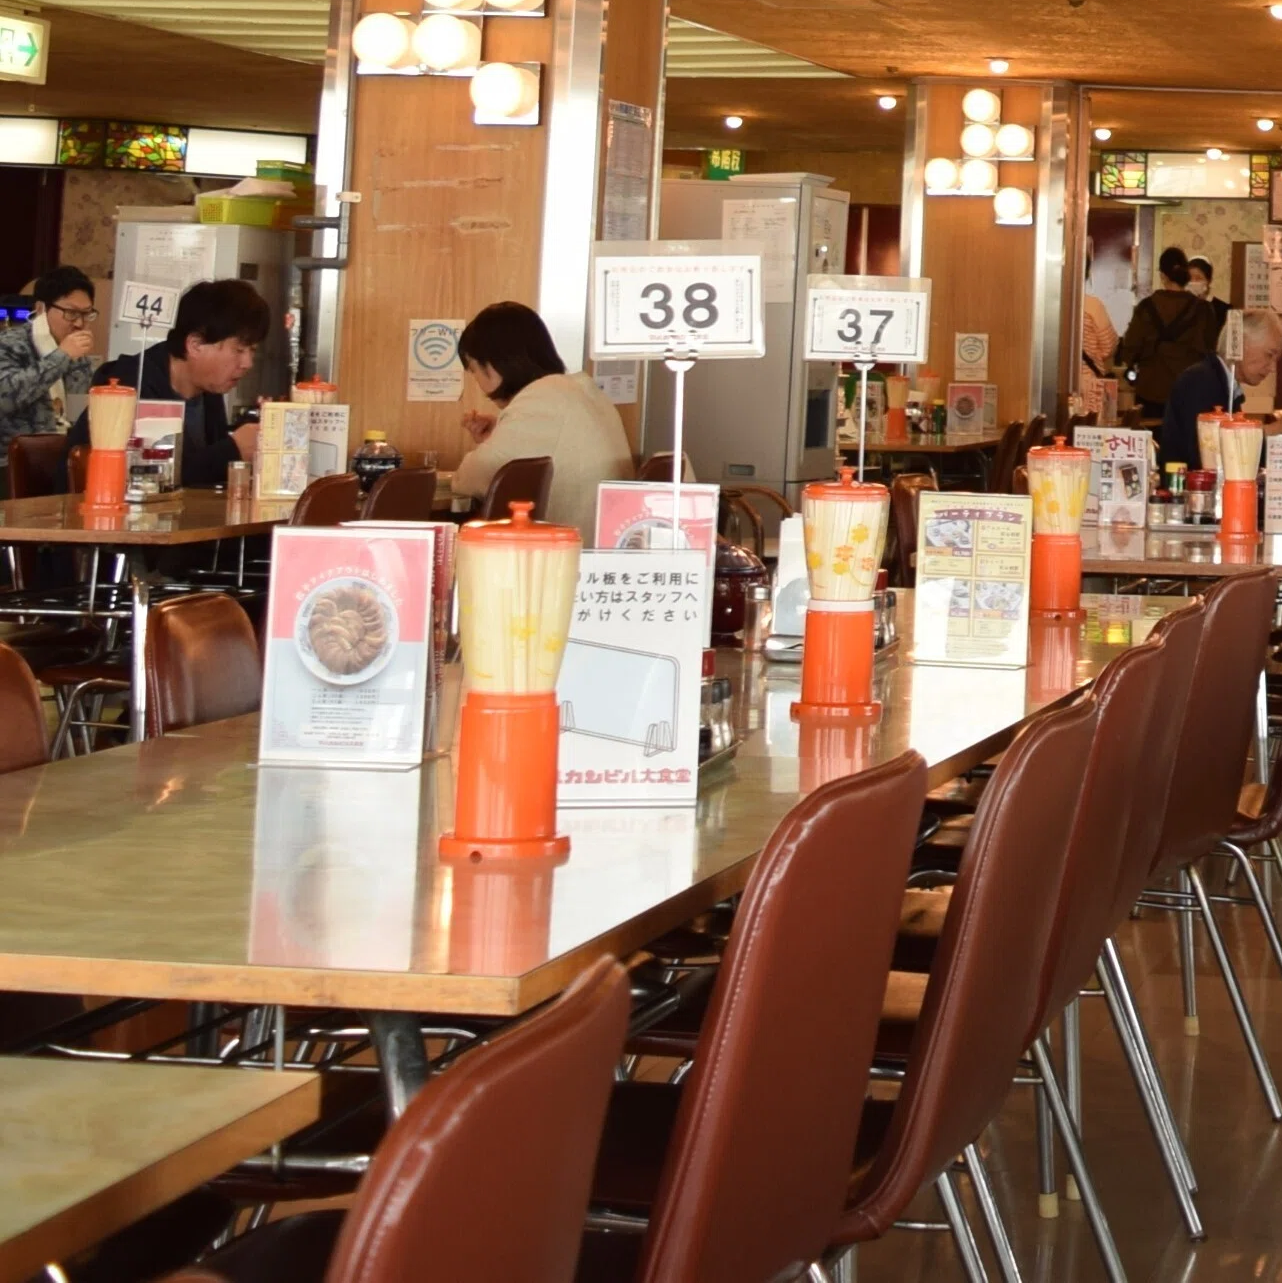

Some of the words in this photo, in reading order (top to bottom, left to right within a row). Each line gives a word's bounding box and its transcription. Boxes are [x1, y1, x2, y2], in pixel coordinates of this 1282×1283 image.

[135, 294, 164, 317] 44
[639, 282, 719, 329] 38
[837, 308, 895, 345] 37
